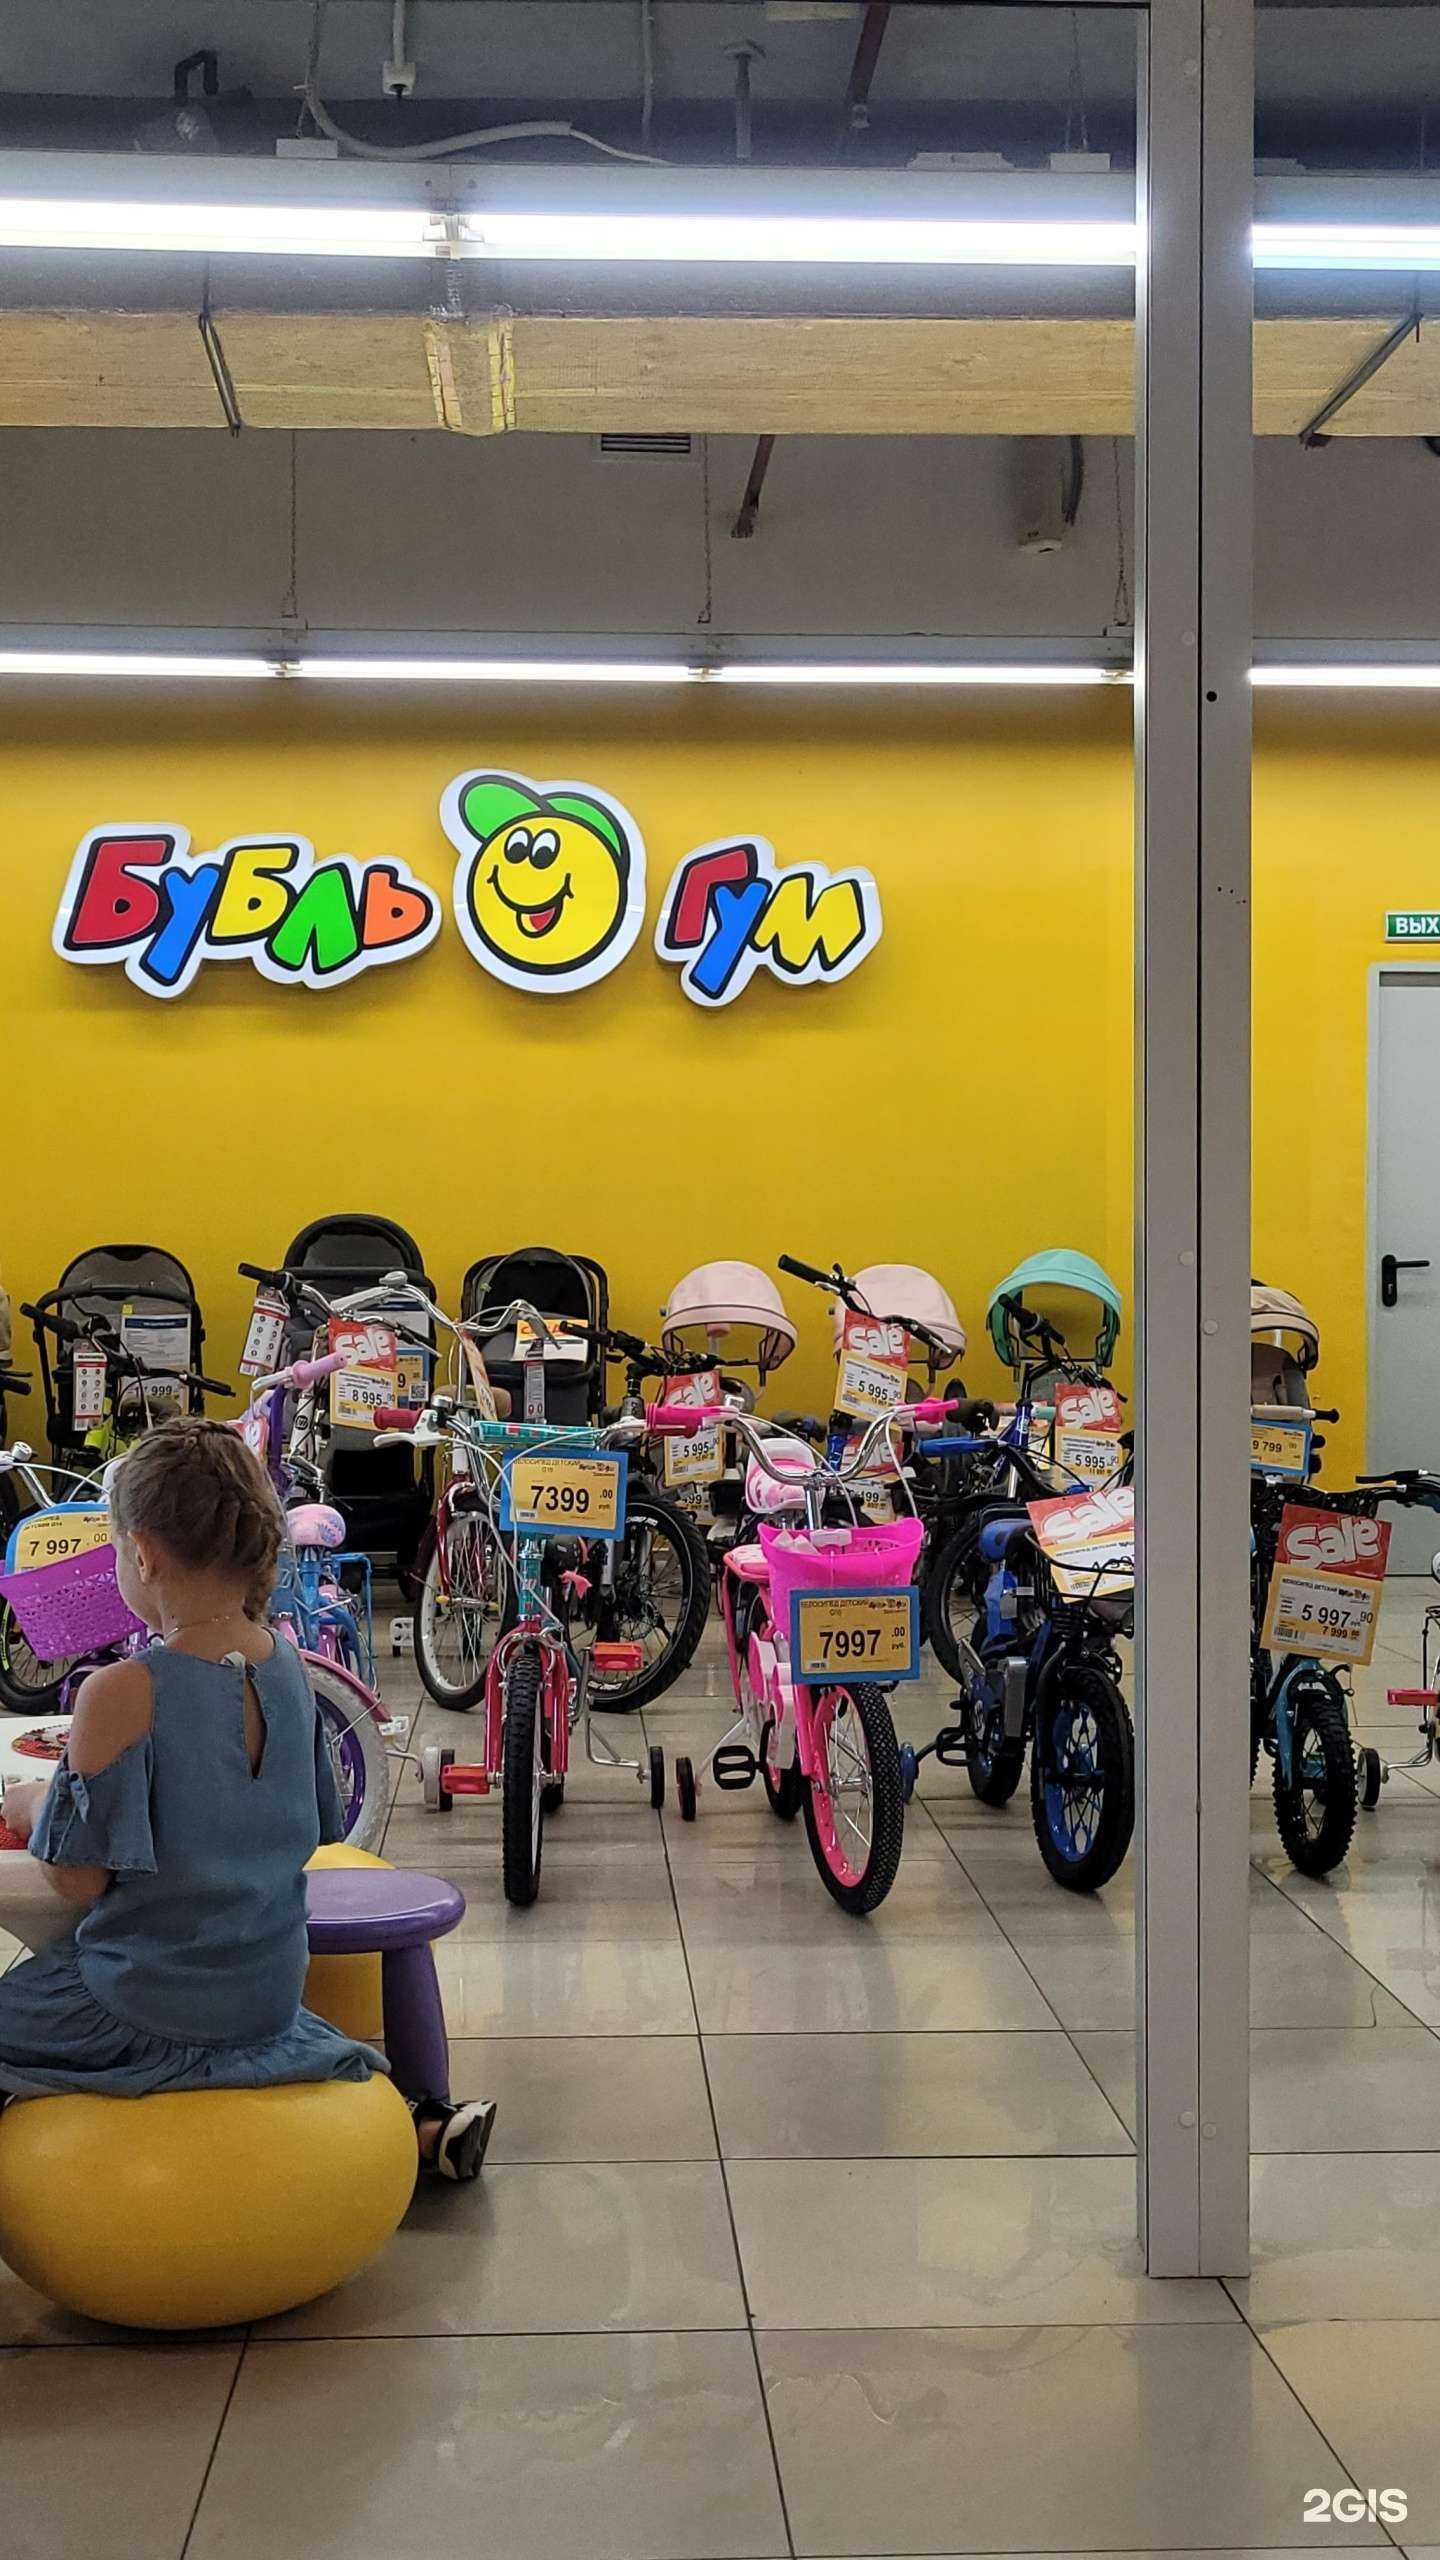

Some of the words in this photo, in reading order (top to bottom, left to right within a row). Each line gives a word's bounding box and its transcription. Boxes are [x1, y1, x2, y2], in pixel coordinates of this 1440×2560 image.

[858, 1380, 866, 1393] 5
[352, 1389, 359, 1402] 8
[362, 1391, 383, 1406] 995
[1075, 1454, 1083, 1468] 5
[1085, 1455, 1105, 1469] 995
[531, 1485, 590, 1514] 7399
[29, 1541, 40, 1557] 7
[46, 1539, 81, 1556] 997
[1301, 1604, 1313, 1622] 5
[1317, 1606, 1352, 1629] 997
[819, 1629, 882, 1659] 7997
[891, 1626, 906, 1637] .00
